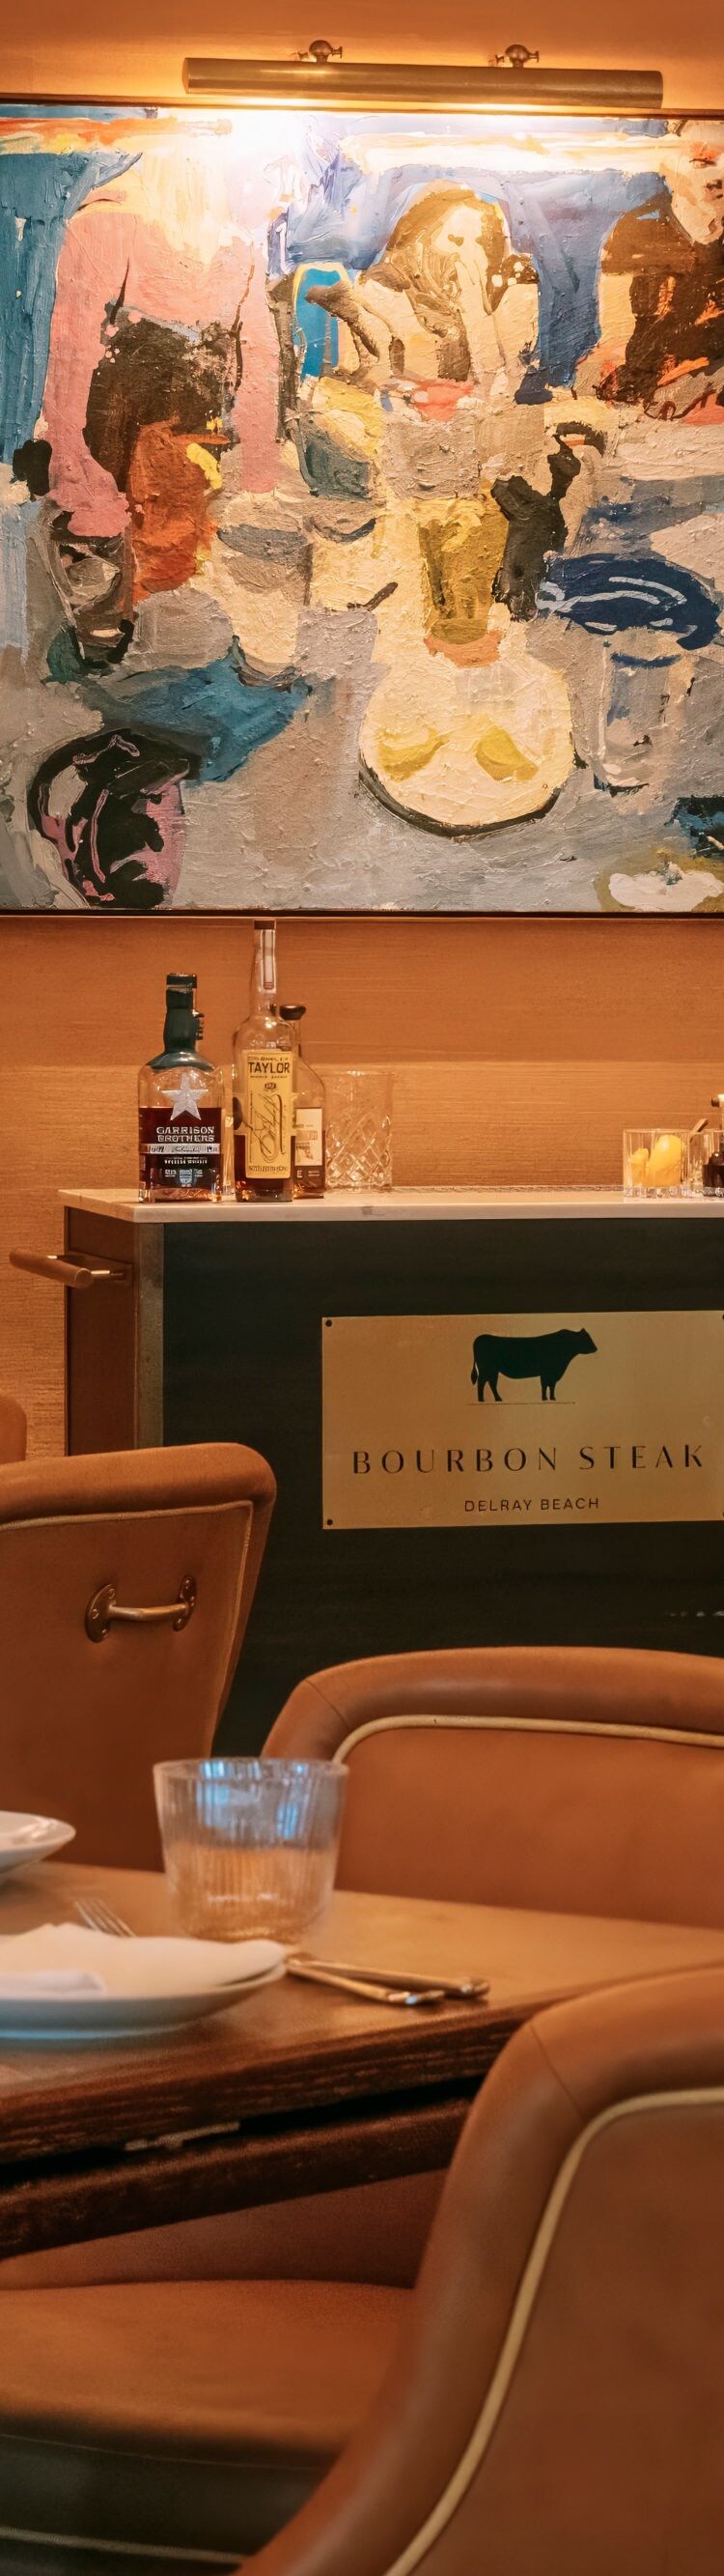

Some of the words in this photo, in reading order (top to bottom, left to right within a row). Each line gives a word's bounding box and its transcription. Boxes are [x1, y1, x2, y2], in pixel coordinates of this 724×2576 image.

[247, 1062, 290, 1074] TAYLOR
[155, 1126, 214, 1135] GARRISON
[157, 1134, 214, 1143] BROTHERS
[352, 1447, 557, 1475] BOURBON
[578, 1444, 704, 1471] STEAK
[463, 1499, 532, 1513] DELRAY
[540, 1497, 599, 1511] BEACH
